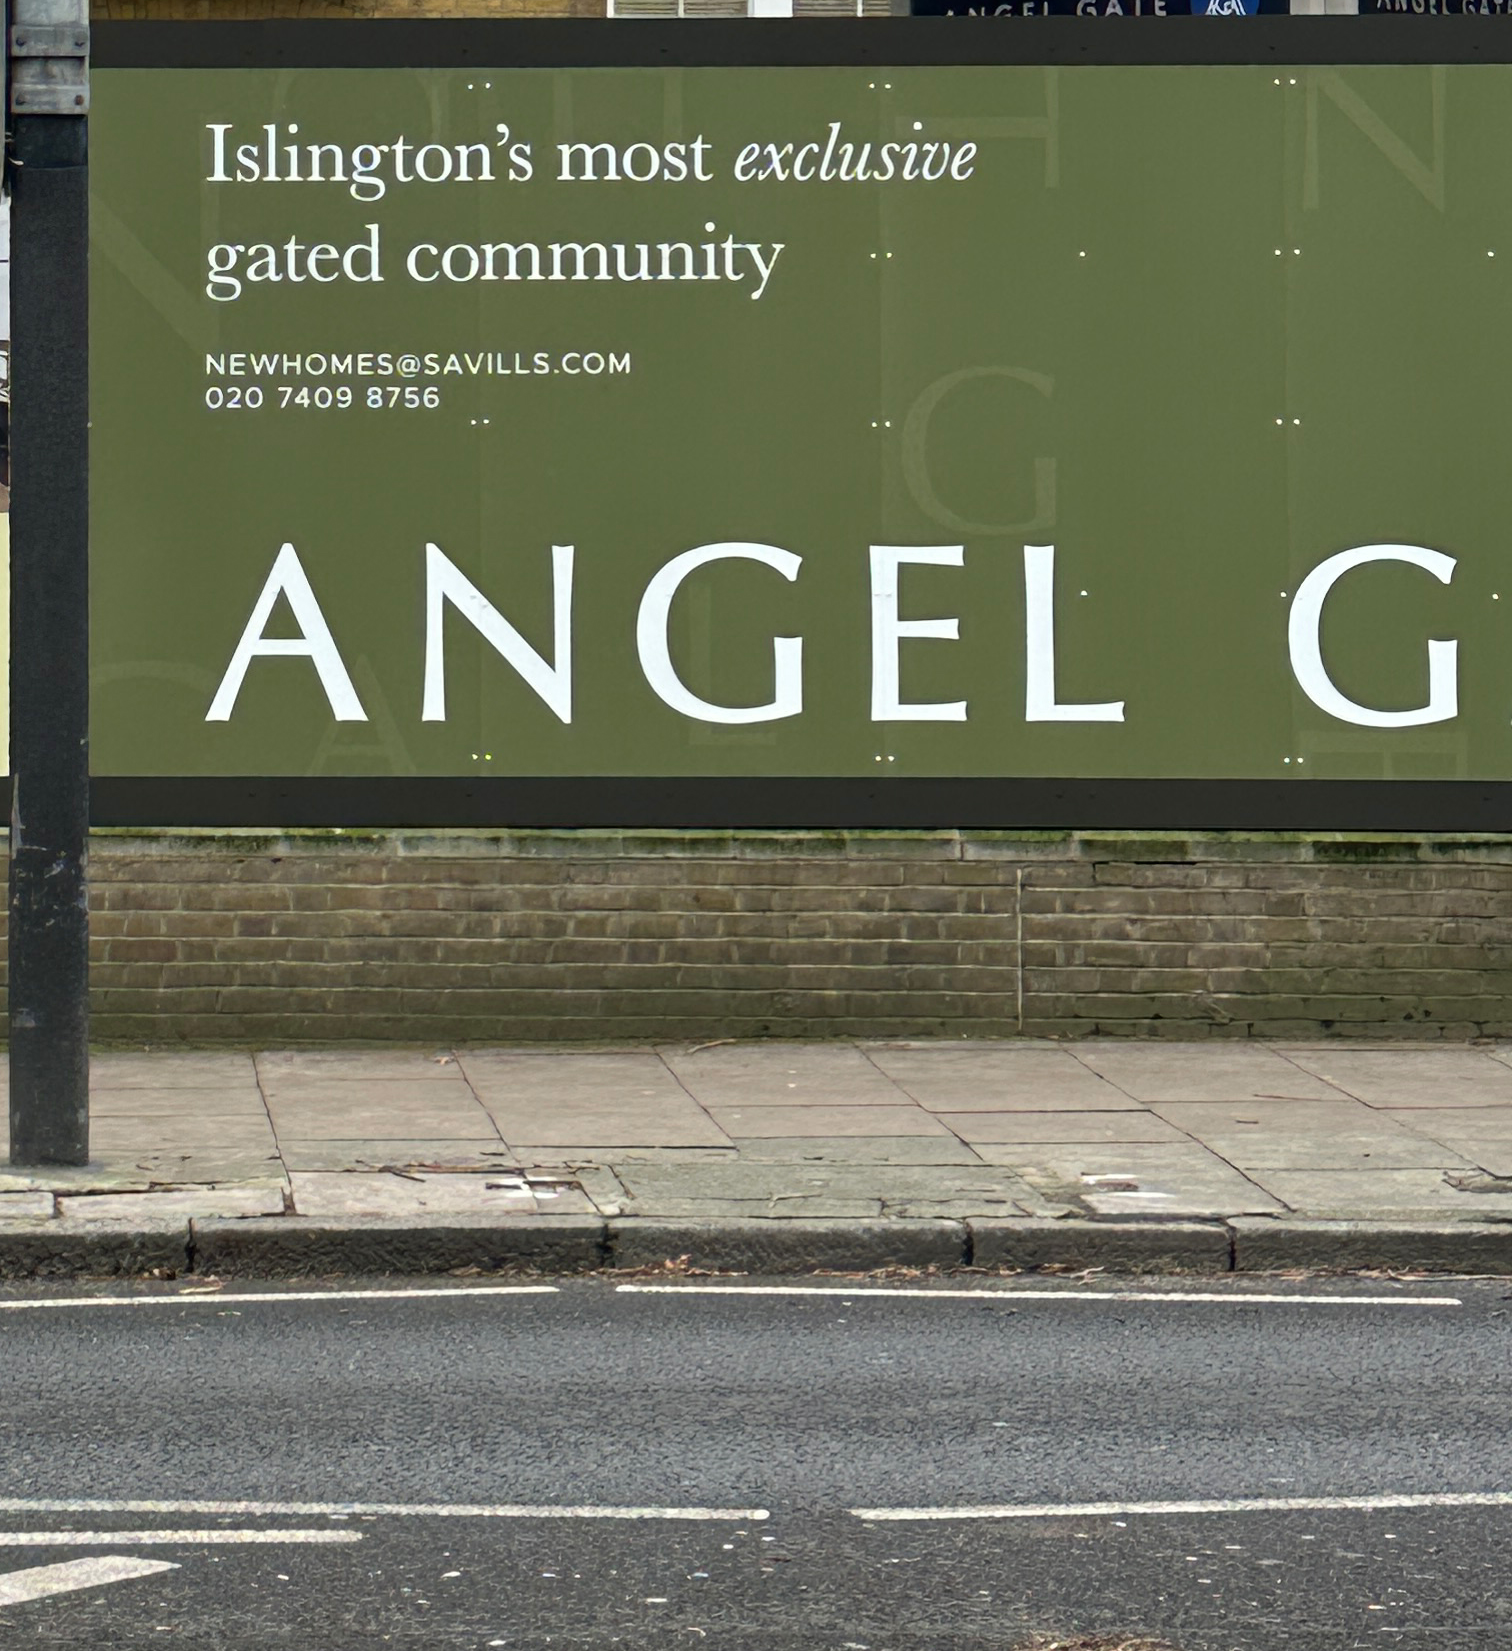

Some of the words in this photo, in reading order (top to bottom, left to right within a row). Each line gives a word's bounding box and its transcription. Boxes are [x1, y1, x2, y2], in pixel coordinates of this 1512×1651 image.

[205, 123, 534, 201] Islington’s
[556, 134, 714, 182] most
[734, 121, 977, 182] exclusive
[205, 223, 385, 301] gated
[406, 221, 786, 300] community
[205, 352, 631, 377] NEWHOMES@SAVILLS.COM
[205, 386, 264, 409] 020
[277, 386, 353, 409] 7409
[366, 386, 440, 409] 8756
[204, 542, 1126, 725] ANGEL
